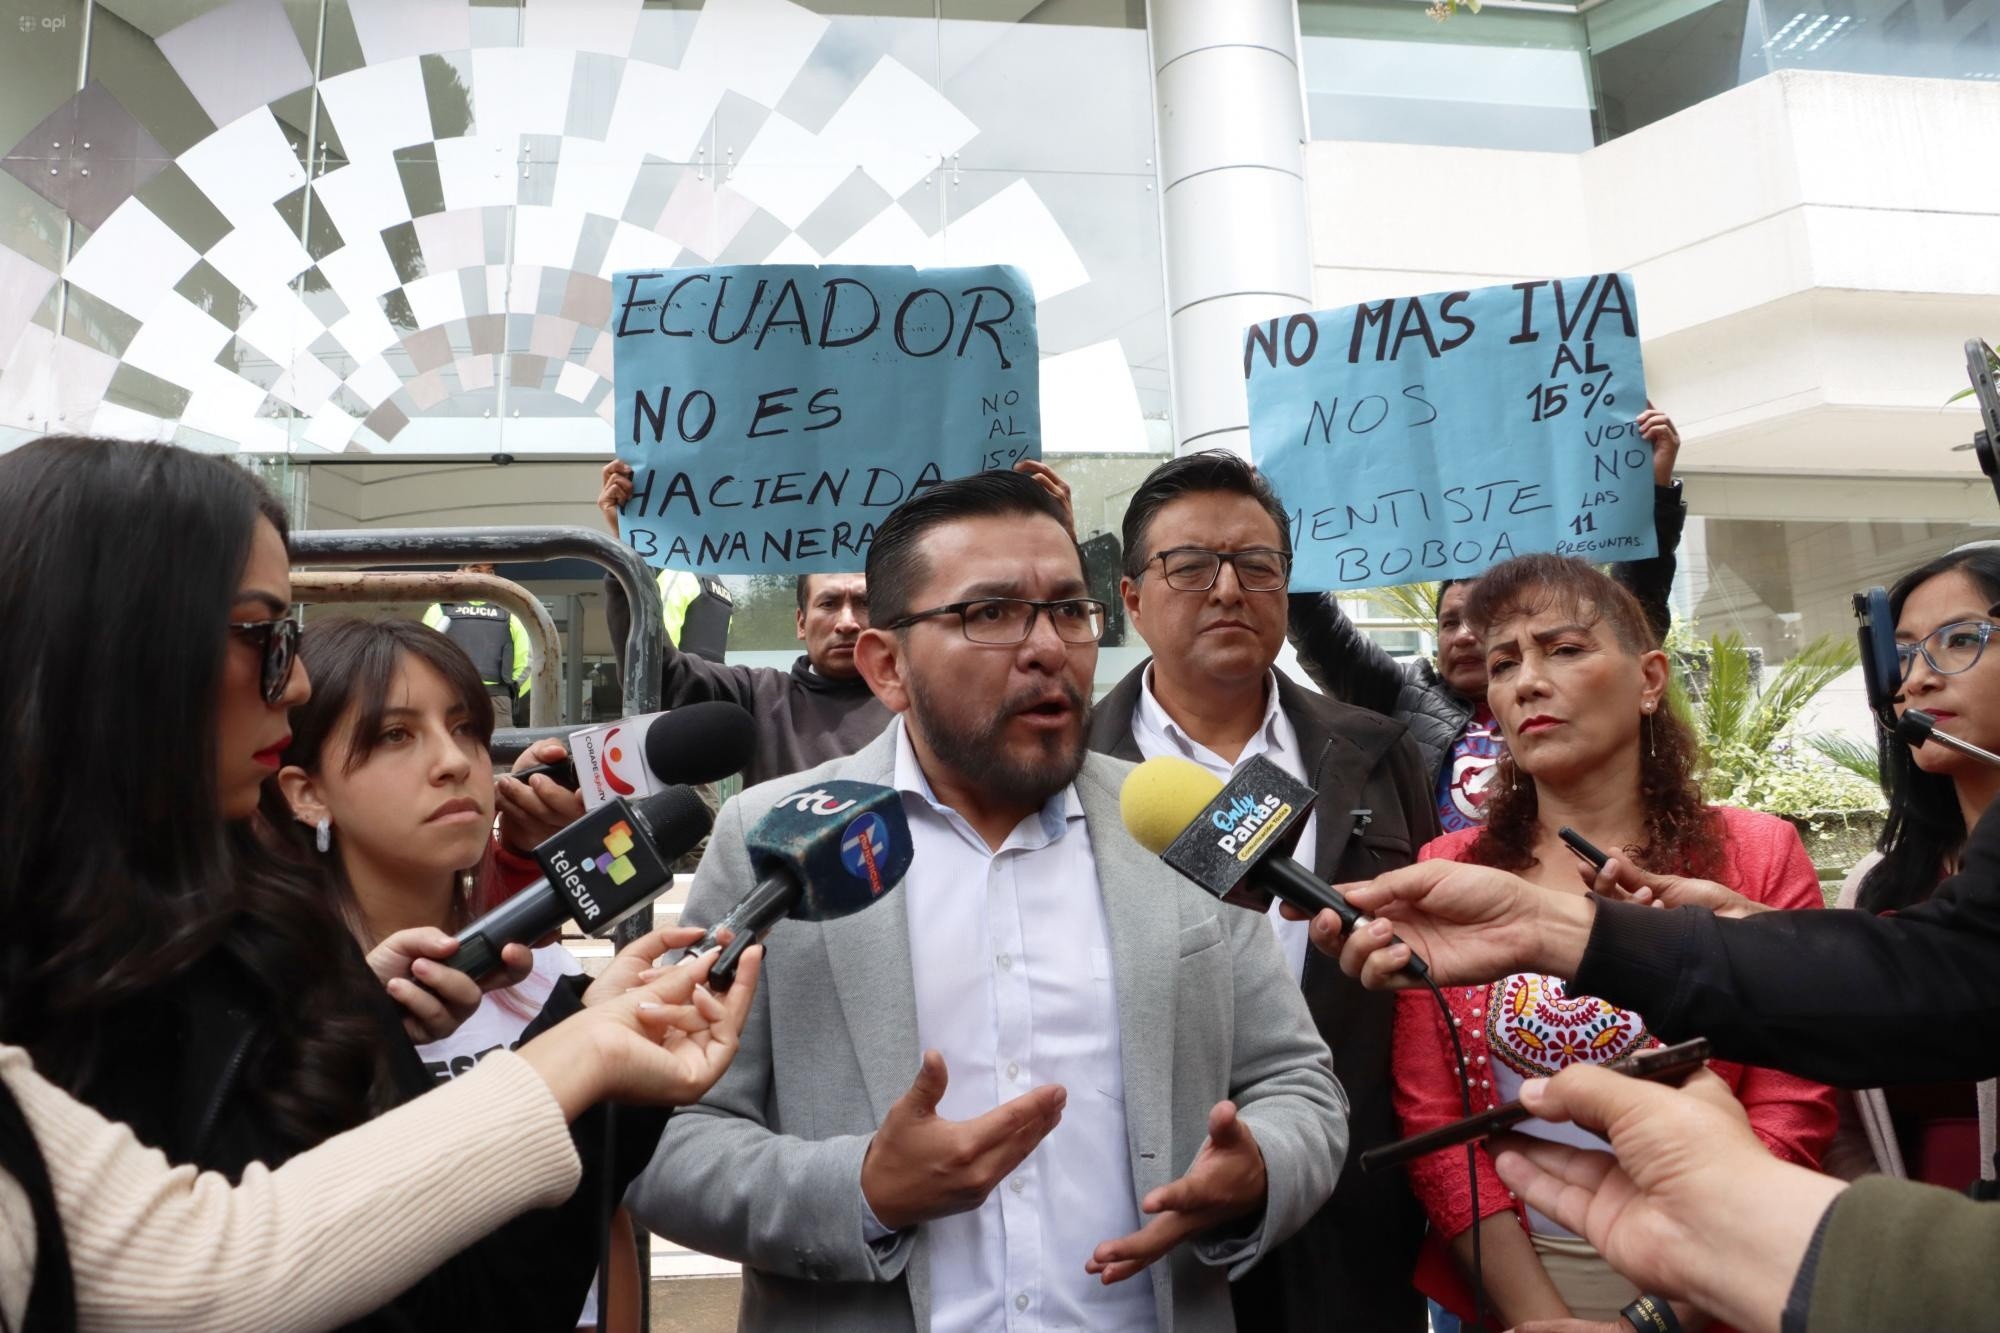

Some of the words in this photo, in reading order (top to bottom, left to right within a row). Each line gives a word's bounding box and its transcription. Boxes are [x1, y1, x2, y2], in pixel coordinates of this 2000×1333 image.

[617, 274, 1014, 369] ECUADOR
[1244, 313, 1318, 379] NO
[1348, 291, 1475, 363] MAS
[1508, 273, 1637, 344] IVA
[1551, 343, 1611, 378] AL
[633, 387, 716, 445] NO
[747, 387, 842, 438] ES
[982, 390, 1019, 416] NO
[1304, 385, 1437, 445] NOS
[1526, 371, 1615, 422] 15%
[989, 415, 1026, 439] AL
[1585, 421, 1638, 447] VOT
[1595, 449, 1645, 482] NO
[620, 462, 943, 517] HACIENDA
[1581, 491, 1619, 508] LAS
[1569, 511, 1597, 535] 11
[1336, 531, 1517, 582] BOBOA
[585, 736, 599, 771] CORAPE
[1217, 794, 1281, 855] Panas
